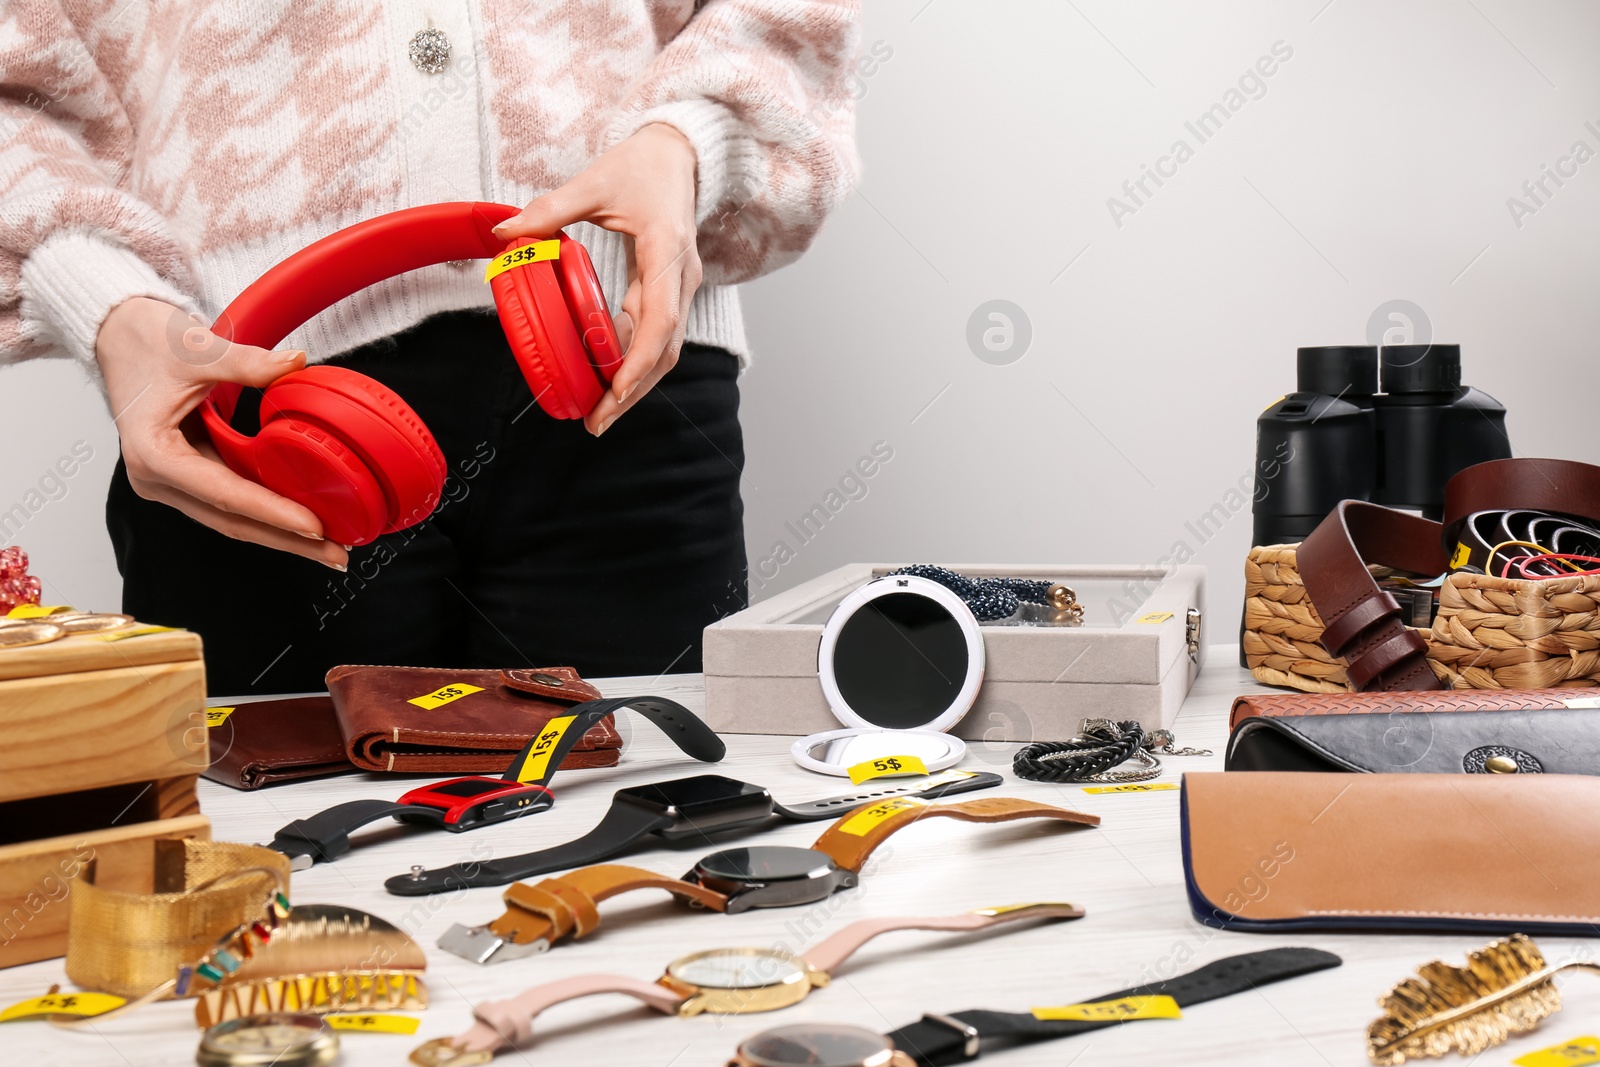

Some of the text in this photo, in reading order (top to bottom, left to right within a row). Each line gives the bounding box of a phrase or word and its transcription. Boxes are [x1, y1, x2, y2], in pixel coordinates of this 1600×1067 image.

[502, 247, 536, 268] 33$
[431, 686, 463, 702] 15$
[532, 728, 560, 760] 15$
[873, 757, 901, 771] 5$
[868, 797, 904, 818] 35$
